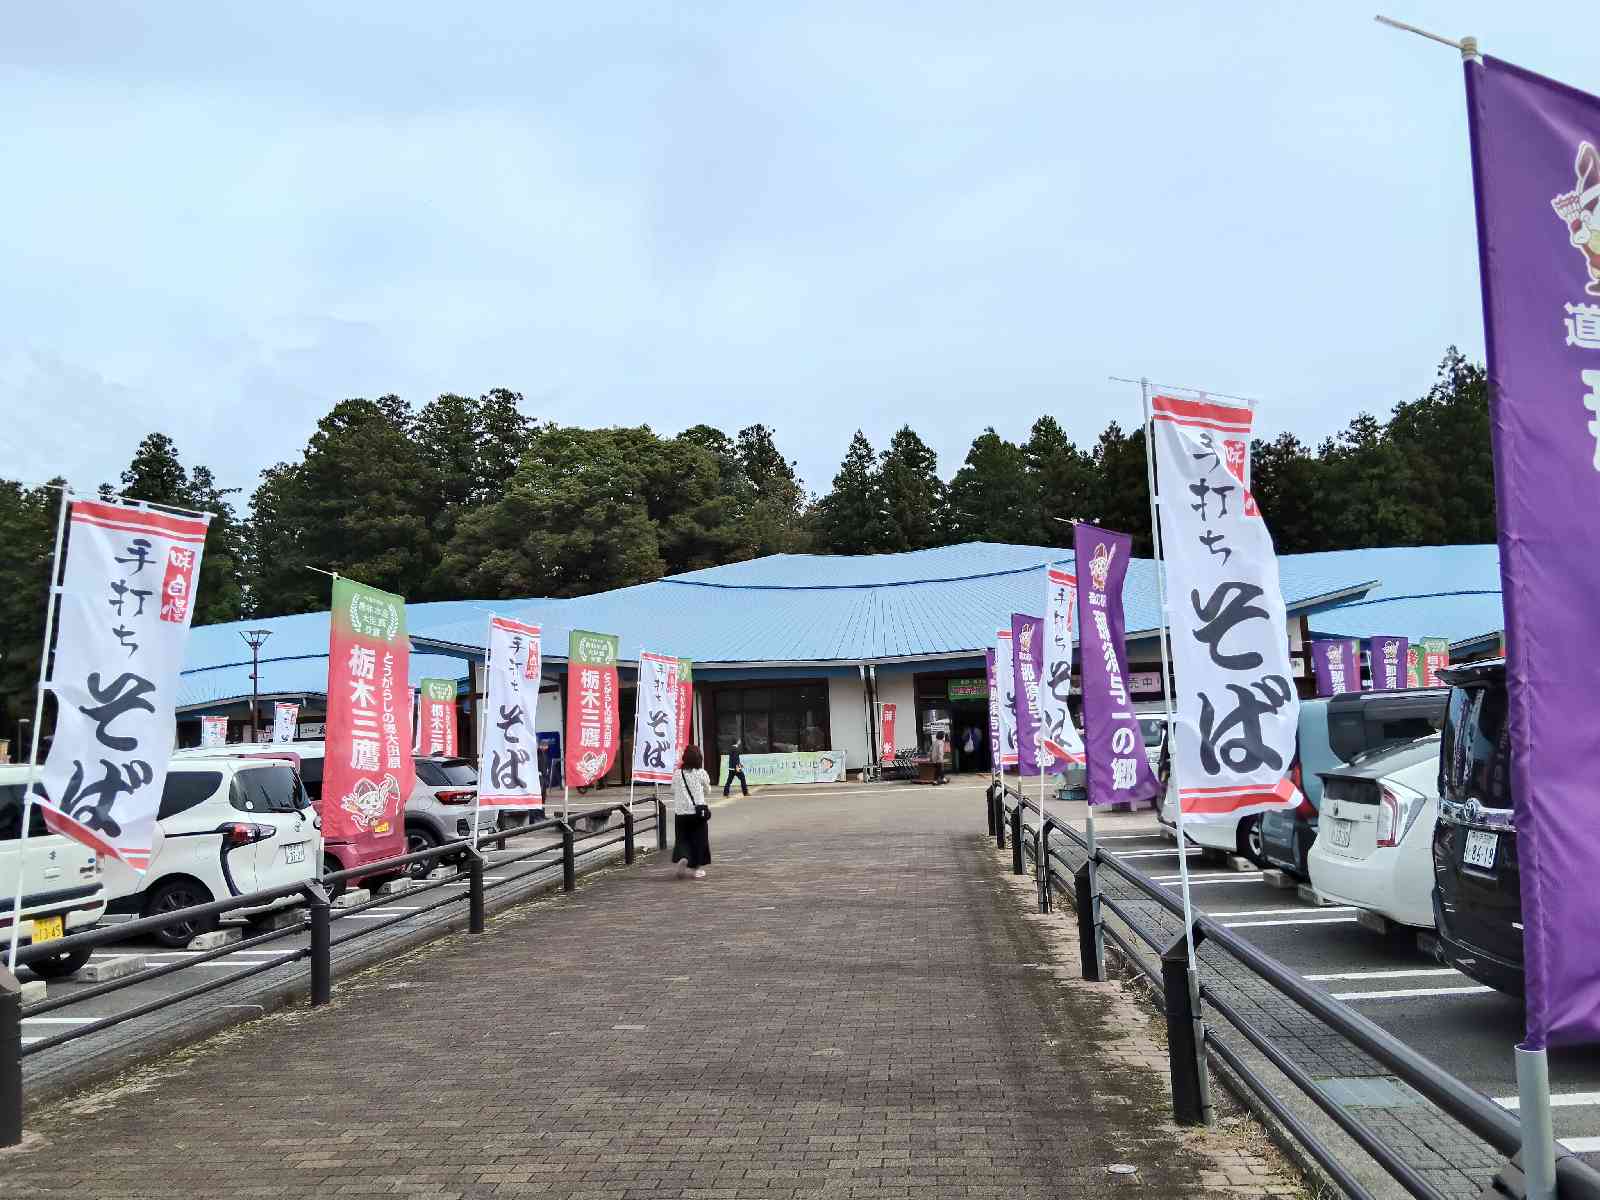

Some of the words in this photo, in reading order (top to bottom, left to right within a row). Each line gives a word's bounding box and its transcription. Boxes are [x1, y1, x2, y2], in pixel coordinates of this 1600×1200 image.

[349, 645, 380, 771] 栃木三鷹
[581, 669, 600, 748] 栃木三鷹
